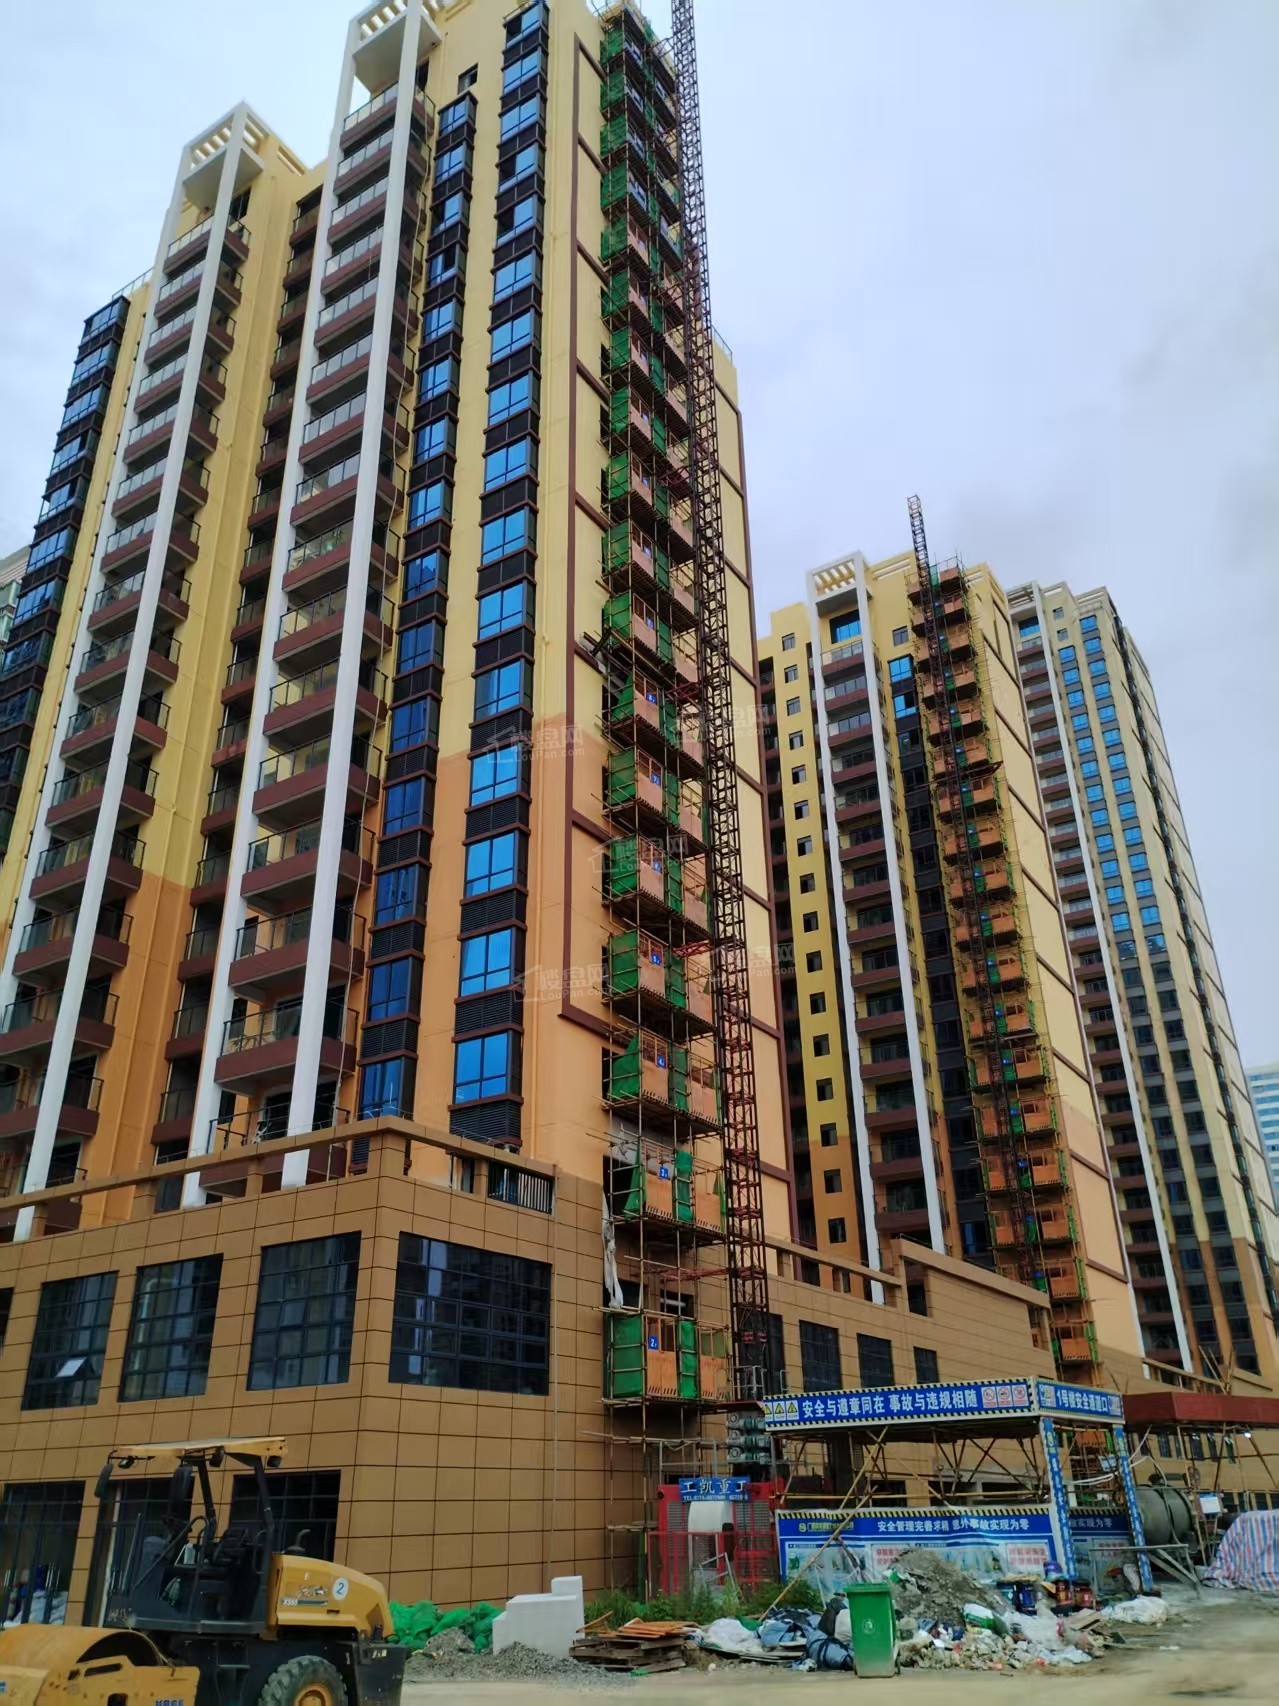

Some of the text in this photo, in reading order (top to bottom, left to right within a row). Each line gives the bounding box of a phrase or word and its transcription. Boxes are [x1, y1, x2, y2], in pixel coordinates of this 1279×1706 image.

[802, 1389, 978, 1419] 安全与遵章同在 事故与违规相随
[681, 1478, 747, 1494] 工凯重工
[336, 1582, 345, 1595] 2
